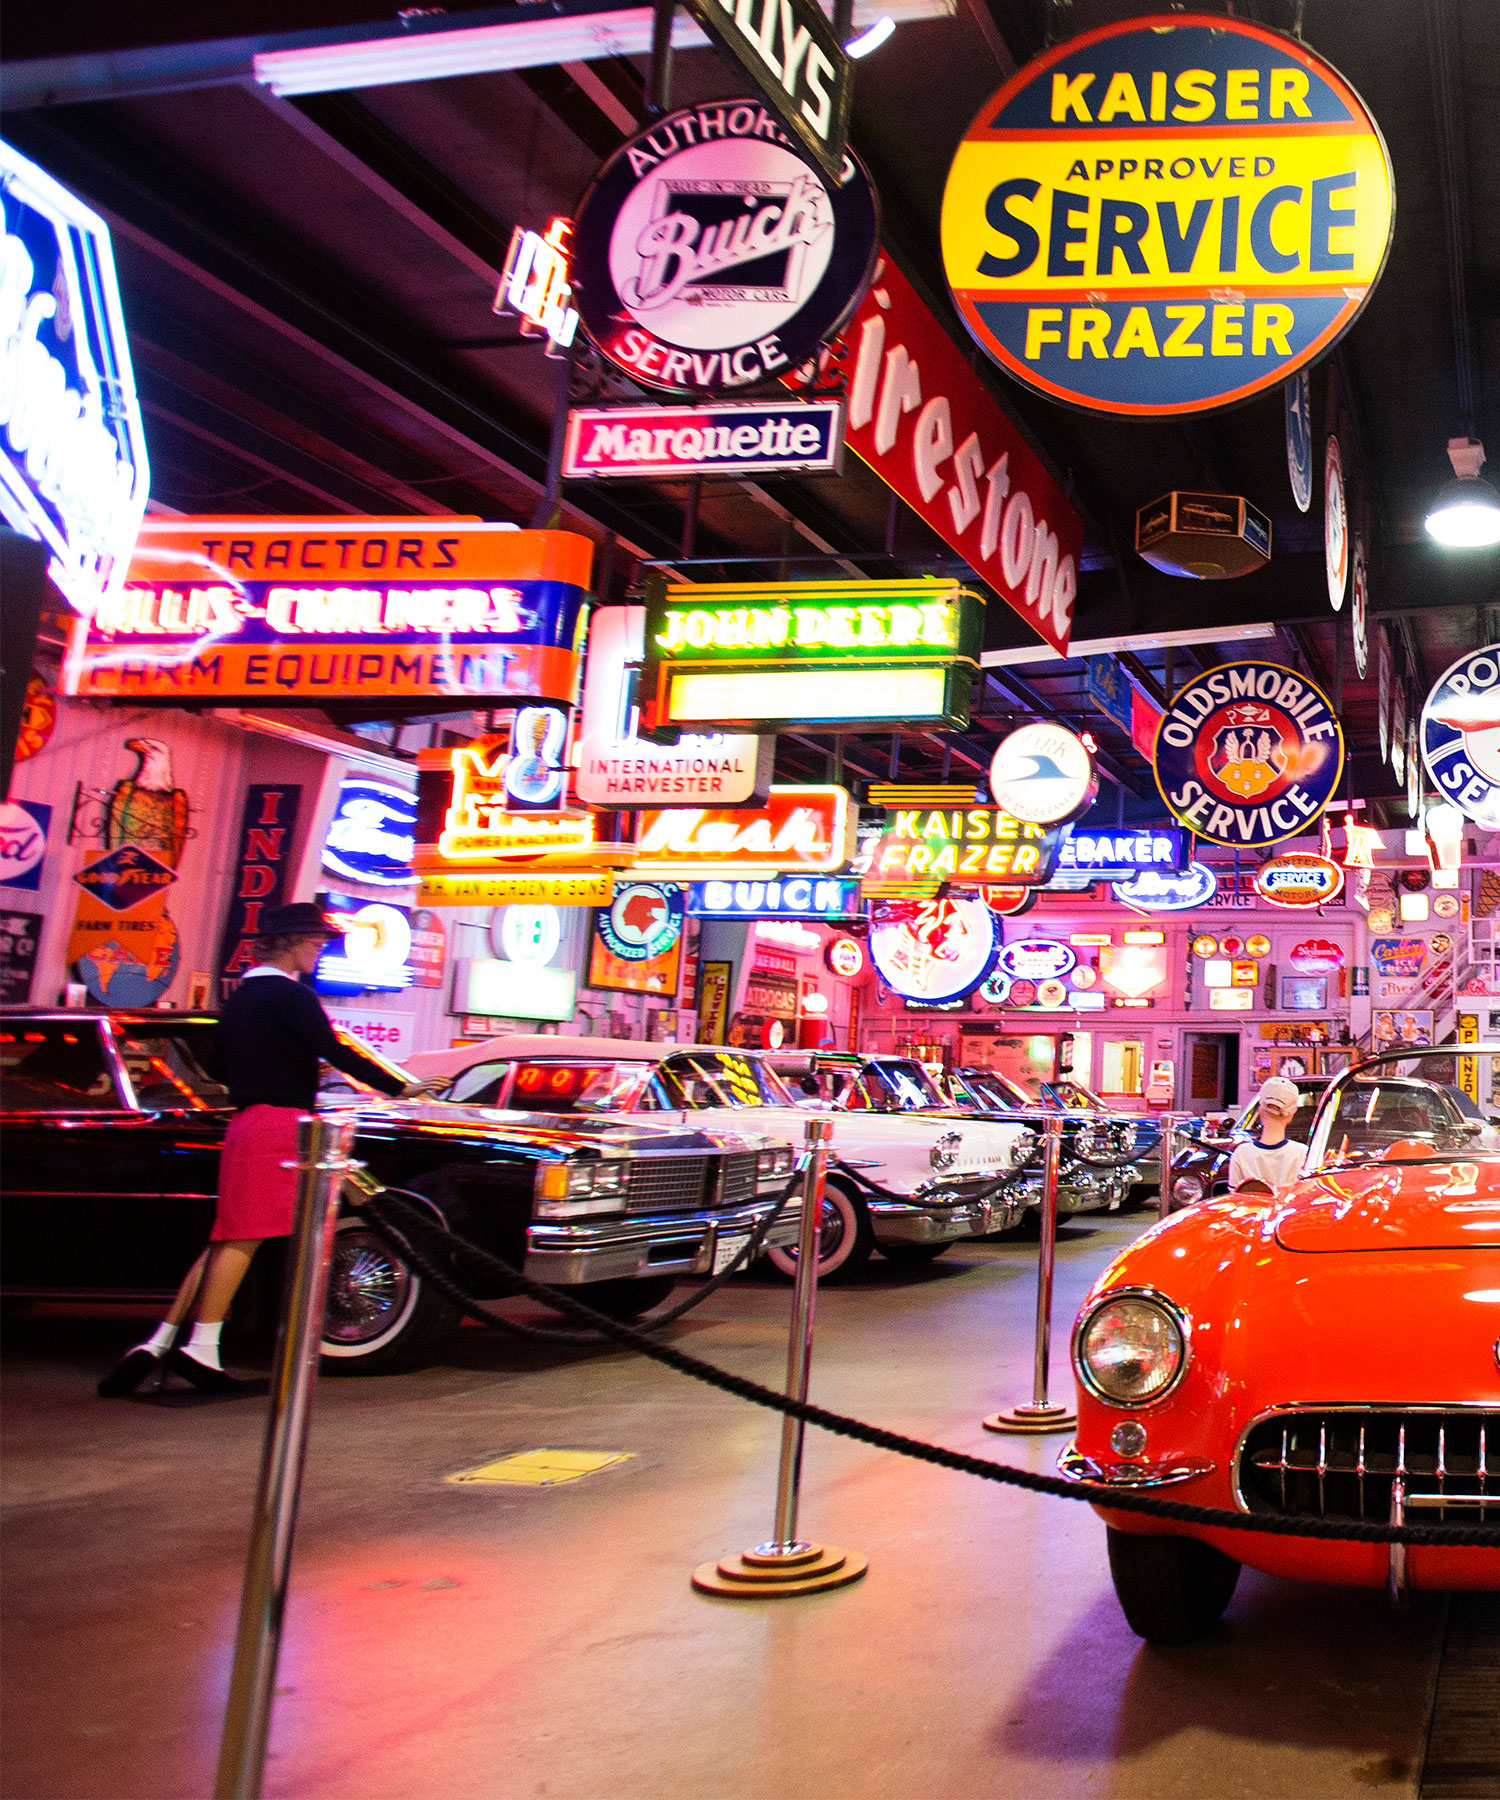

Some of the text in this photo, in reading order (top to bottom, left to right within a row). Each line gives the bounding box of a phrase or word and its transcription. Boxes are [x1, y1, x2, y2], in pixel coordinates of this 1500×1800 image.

[1050, 68, 1313, 123] KAISER
[1066, 156, 1276, 181] APPROVED
[620, 174, 834, 311] Buick
[976, 170, 1358, 278] SERVICE
[1025, 303, 1295, 360] FRAZER
[613, 328, 788, 387] SERVICE
[582, 418, 821, 462] Marquette
[797, 258, 1078, 641] irestone
[202, 538, 461, 570] TRACTORS
[655, 603, 956, 651] JOHN DEERE
[91, 653, 518, 689] FARM EQUIPMENT
[1163, 668, 1336, 748] OLDSMOBILE
[590, 758, 744, 775] INTERNATIONAL
[607, 776, 723, 794] HARVESTER
[639, 805, 831, 853] Nash
[1171, 781, 1319, 840] SERVICE
[878, 844, 1041, 875] FRAZER
[1273, 872, 1322, 884] SERVICE
[1274, 858, 1320, 868] UNITED
[569, 878, 608, 896] SONS
[704, 880, 842, 911] BUICK
[1203, 893, 1251, 907] ERVICE
[1274, 888, 1320, 899] MOTORS
[76, 920, 156, 932] FARM TIRES
[599, 912, 647, 959] AUTHORIZED
[649, 912, 683, 958] SERVICE
